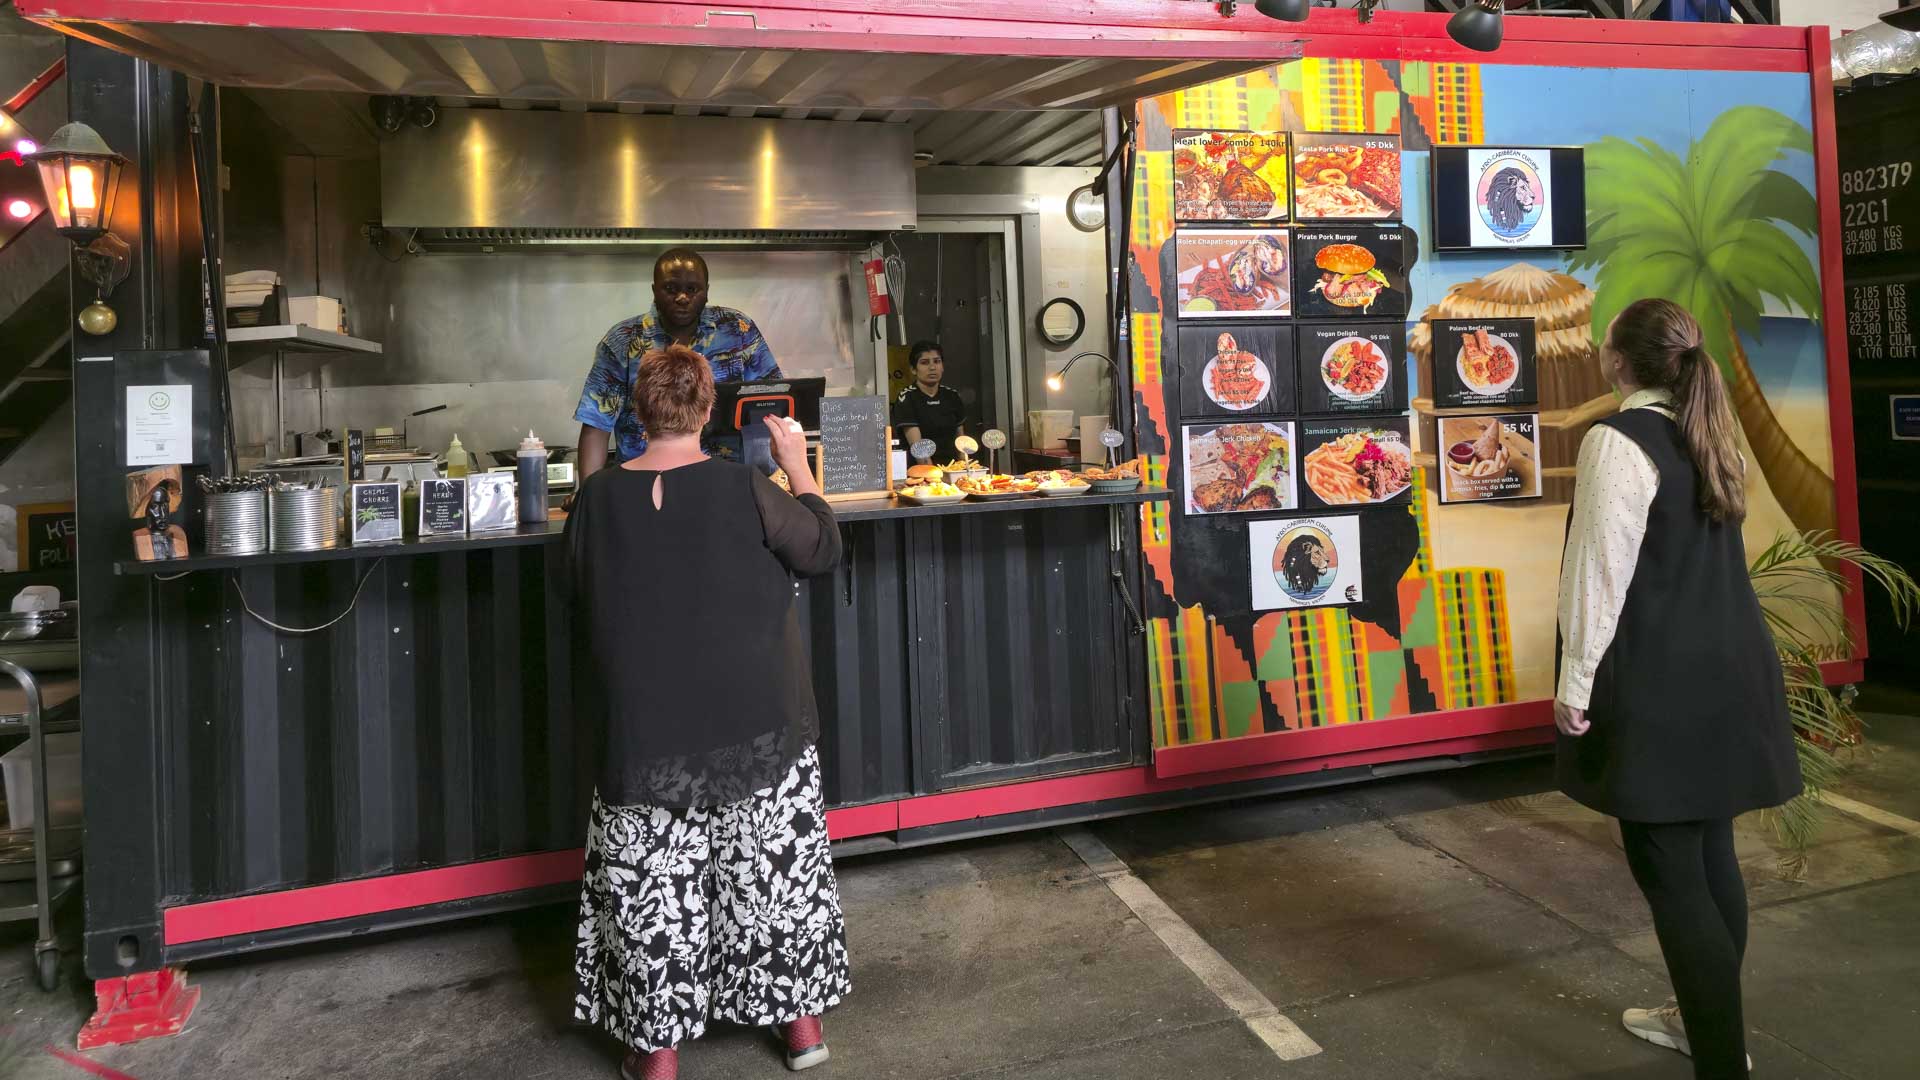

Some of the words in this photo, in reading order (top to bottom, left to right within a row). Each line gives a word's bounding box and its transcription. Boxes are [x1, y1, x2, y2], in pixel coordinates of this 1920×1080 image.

[1174, 138, 1197, 146] Meat
[1199, 138, 1221, 146] lover
[1224, 139, 1255, 147] combo
[1366, 141, 1376, 149] 95
[1378, 141, 1394, 149] Dkk
[1842, 161, 1912, 195] 882379
[1845, 198, 1888, 227] 22G1
[1845, 228, 1876, 243] 30.480
[1883, 225, 1902, 239] KGS
[1846, 240, 1877, 256] 67.200
[1884, 238, 1903, 252] LBS
[1854, 286, 1879, 299] 2.185
[1886, 284, 1906, 297] KGS
[1854, 298, 1880, 311] 4.820
[1887, 296, 1906, 309] LBS
[1849, 310, 1880, 324] 28.295
[1888, 309, 1907, 322] KGS
[1850, 322, 1881, 336] 62.380
[1889, 321, 1908, 334] LBS
[1861, 335, 1882, 348] 33.2
[1889, 334, 1912, 346] CU.M
[1858, 346, 1882, 359] 1.170
[1890, 345, 1917, 358] CU.FT
[1305, 427, 1338, 435] Jamaican
[1503, 424, 1517, 433] 55
[1520, 423, 1533, 432] Kr
